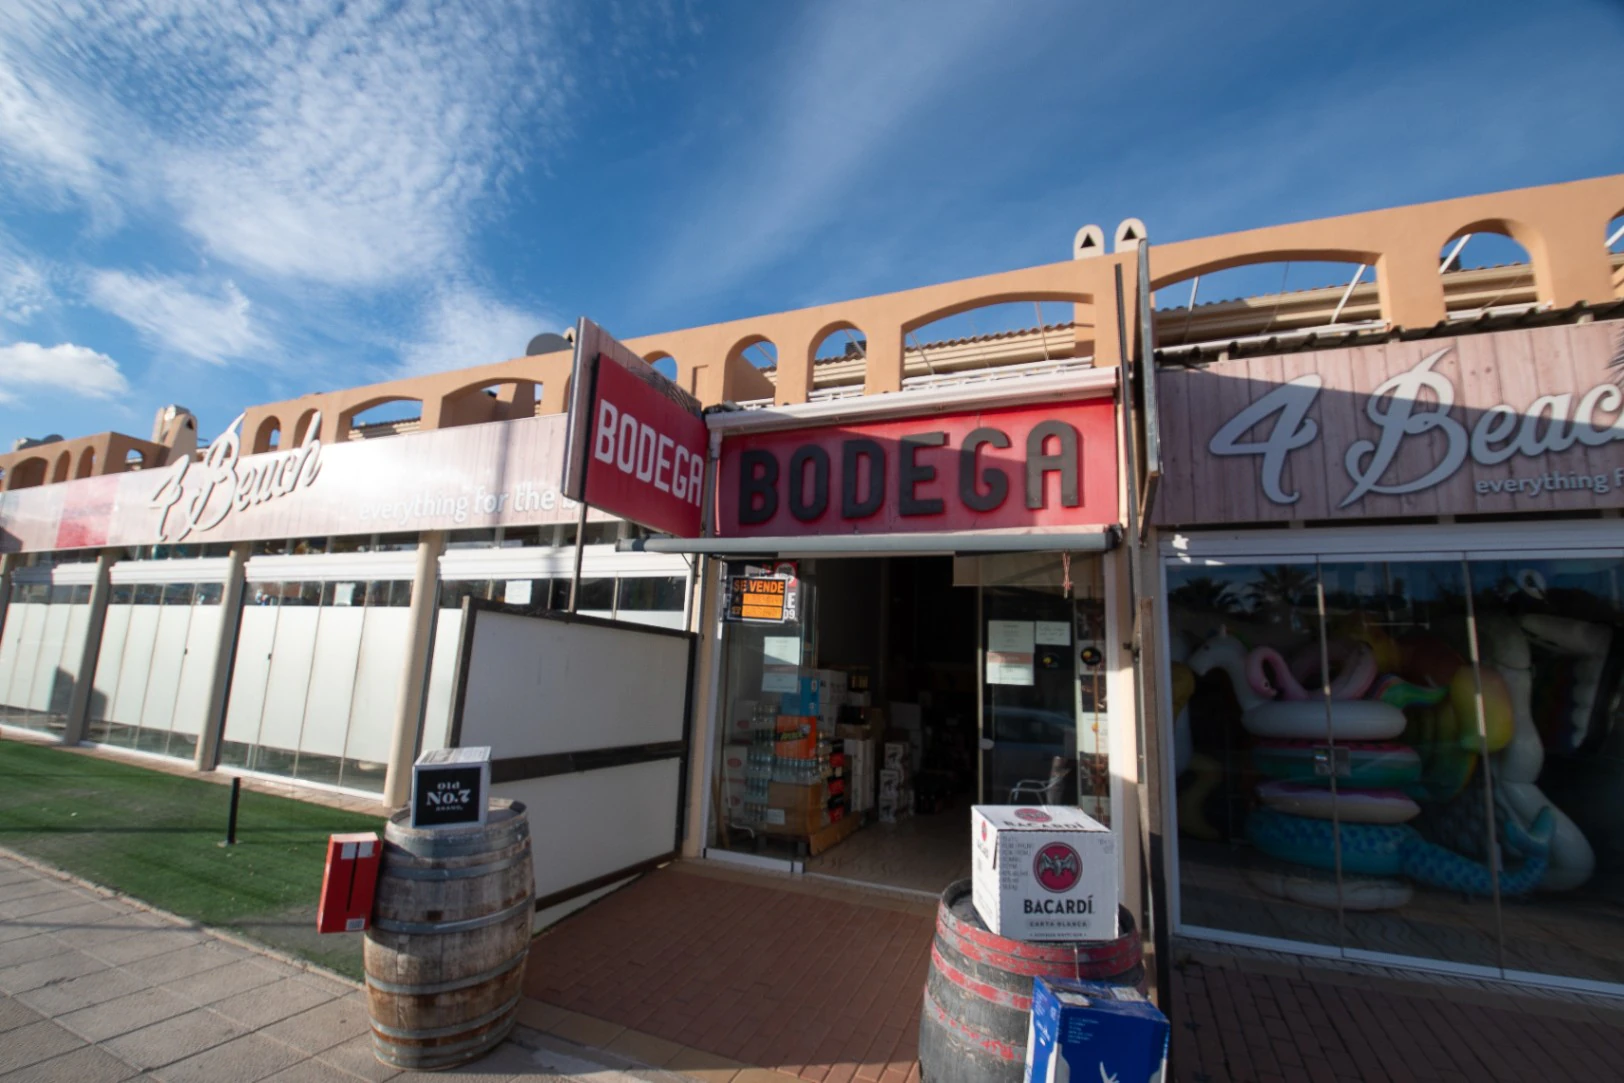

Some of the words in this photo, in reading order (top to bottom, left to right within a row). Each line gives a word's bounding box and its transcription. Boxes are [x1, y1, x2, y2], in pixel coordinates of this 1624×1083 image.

[1209, 373, 1322, 504] 4
[1339, 347, 1624, 509] Beac
[595, 399, 704, 508] BODEGA
[738, 419, 1080, 525] BODEGA
[149, 454, 190, 542] 4
[177, 411, 323, 542] Beach
[1475, 470, 1610, 497] everything
[359, 490, 470, 525] everything
[473, 485, 509, 514] for
[514, 481, 555, 512] the
[733, 580, 747, 592] SE
[749, 580, 784, 593] VENDE
[426, 788, 471, 806] No.7
[1023, 894, 1094, 914] BACARDÍ
